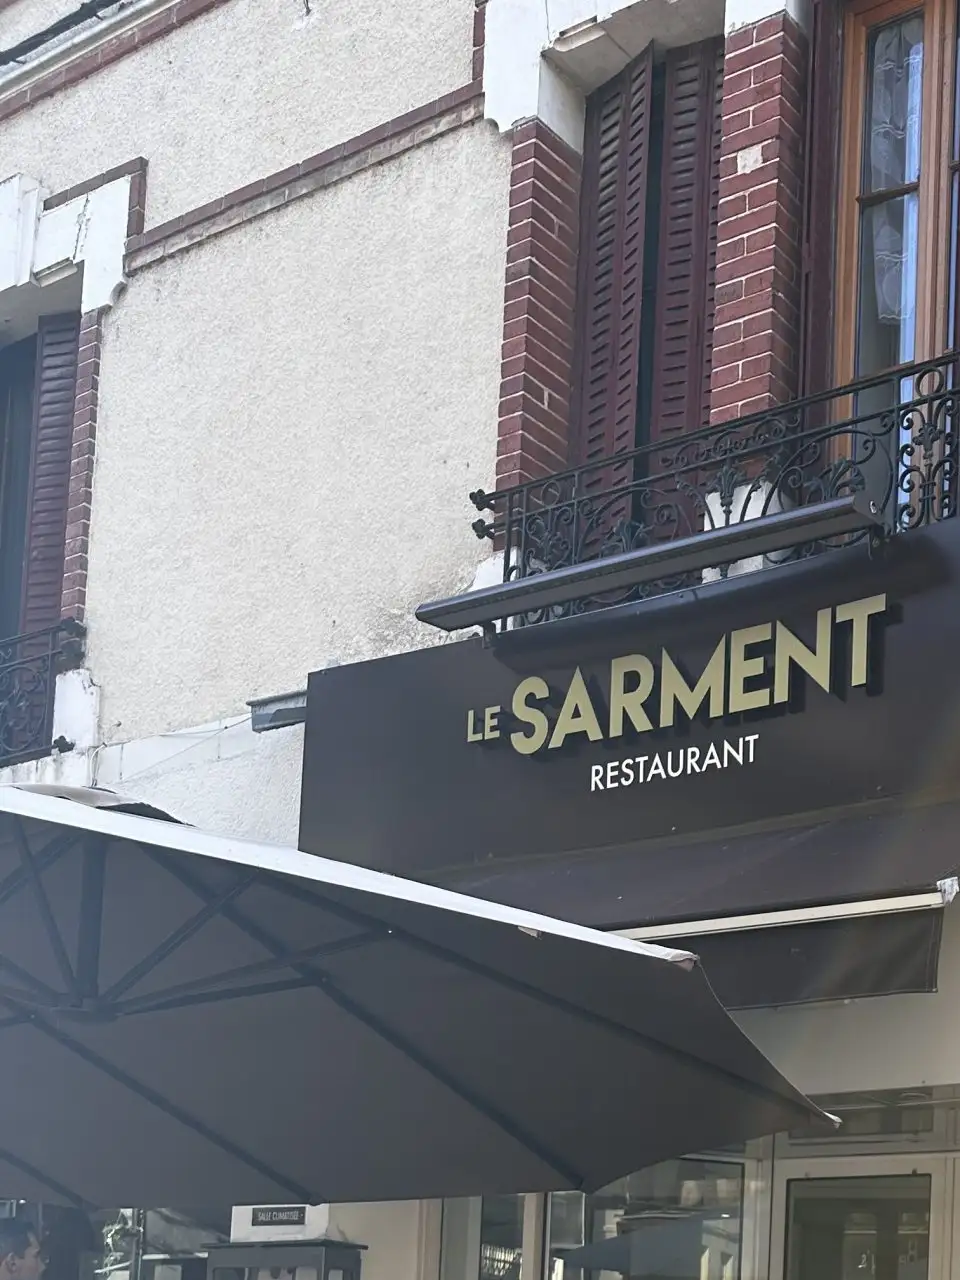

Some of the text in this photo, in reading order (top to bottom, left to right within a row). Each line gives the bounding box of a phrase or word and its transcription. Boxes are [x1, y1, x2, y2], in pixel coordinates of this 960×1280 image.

[467, 593, 887, 755] LE SARMENT
[590, 734, 760, 792] RESTAURANT
